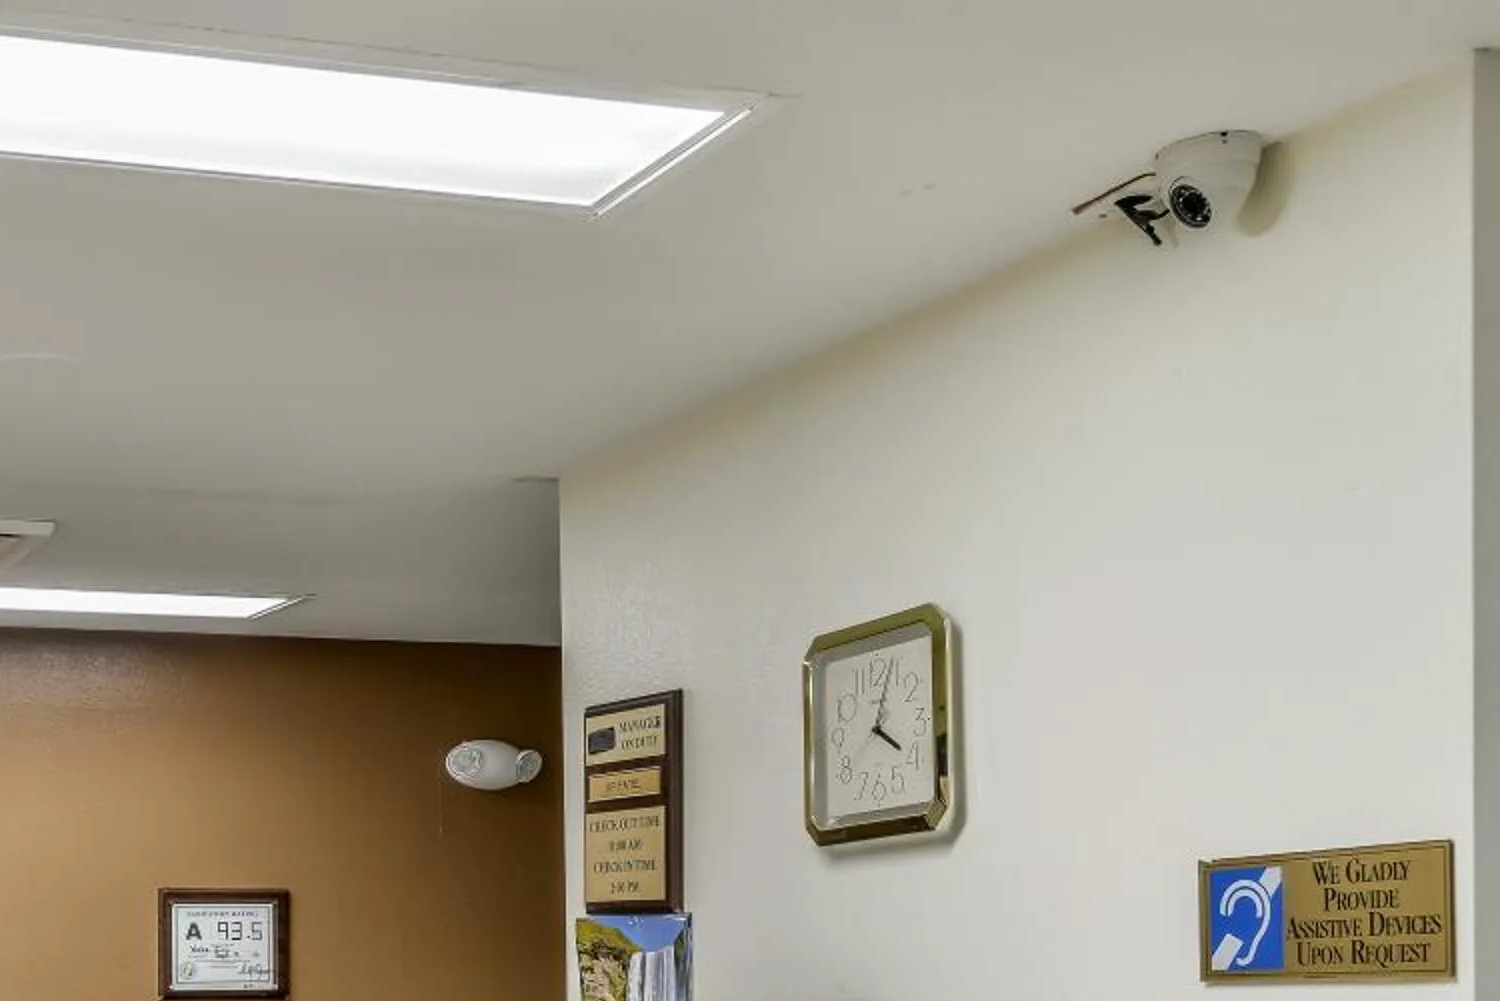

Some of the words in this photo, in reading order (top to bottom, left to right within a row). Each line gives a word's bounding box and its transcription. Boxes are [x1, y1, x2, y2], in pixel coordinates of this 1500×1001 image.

[903, 672, 920, 703] 2
[913, 707, 927, 738] 3
[831, 727, 845, 749] 9
[839, 755, 853, 785] 8
[905, 742, 920, 771] 4
[854, 772, 869, 801] 7
[871, 773, 887, 802] 6
[891, 765, 905, 795] 5
[1323, 887, 1400, 912] PROVIDE
[185, 922, 203, 940] A
[1286, 917, 1363, 940] ASSISTIVE
[1368, 911, 1442, 937] DEVICES
[1296, 942, 1344, 966] UPON
[1350, 939, 1432, 968] REQUEST
